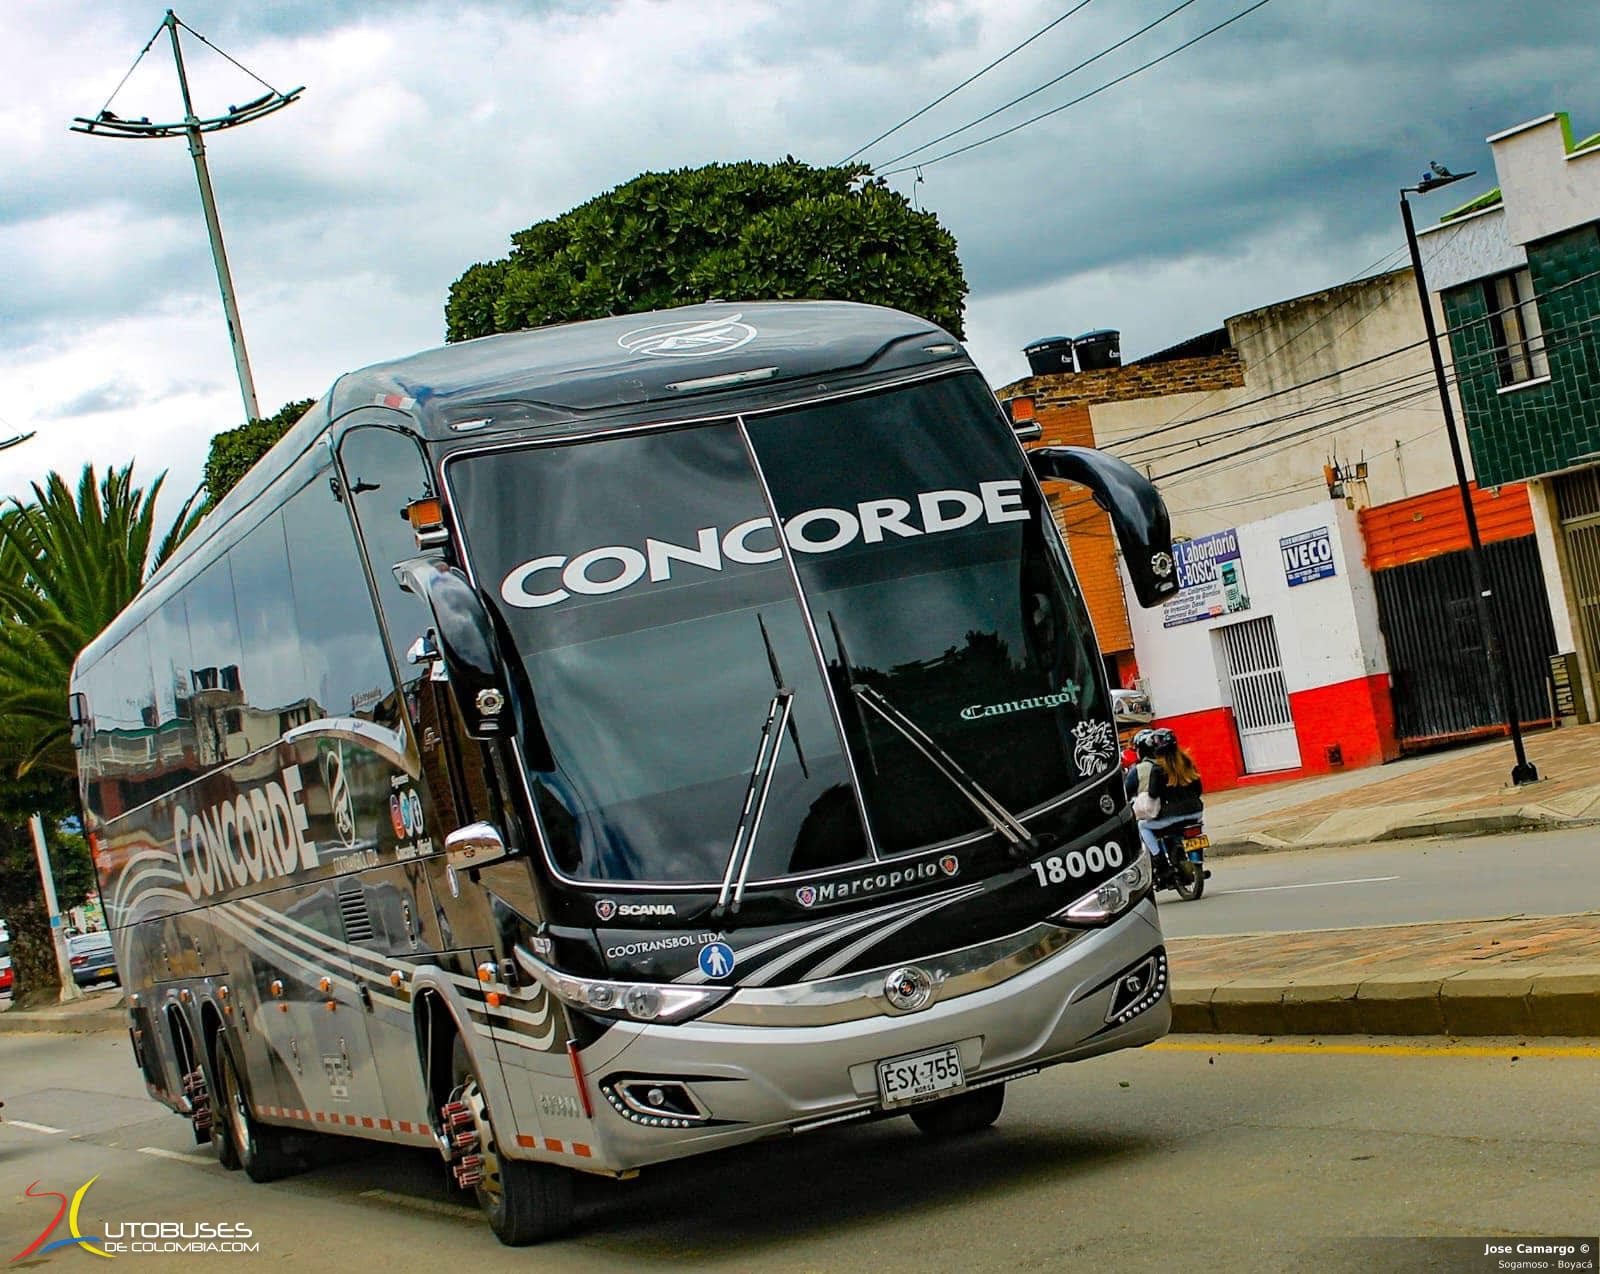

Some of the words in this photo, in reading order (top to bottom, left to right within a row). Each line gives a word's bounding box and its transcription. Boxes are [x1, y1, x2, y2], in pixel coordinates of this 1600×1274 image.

[501, 480, 1031, 608] CONCORDE
[1180, 532, 1236, 564] Laboratorio
[1282, 538, 1331, 571] IVECO
[959, 691, 1070, 721] Camargo
[174, 764, 319, 900] CONCORDE
[1030, 841, 1124, 888] 18000
[818, 863, 937, 901] Marcopolo
[618, 904, 676, 916] SCANIA
[606, 935, 696, 959] COOTRANSBOL
[698, 932, 726, 944] LTDA
